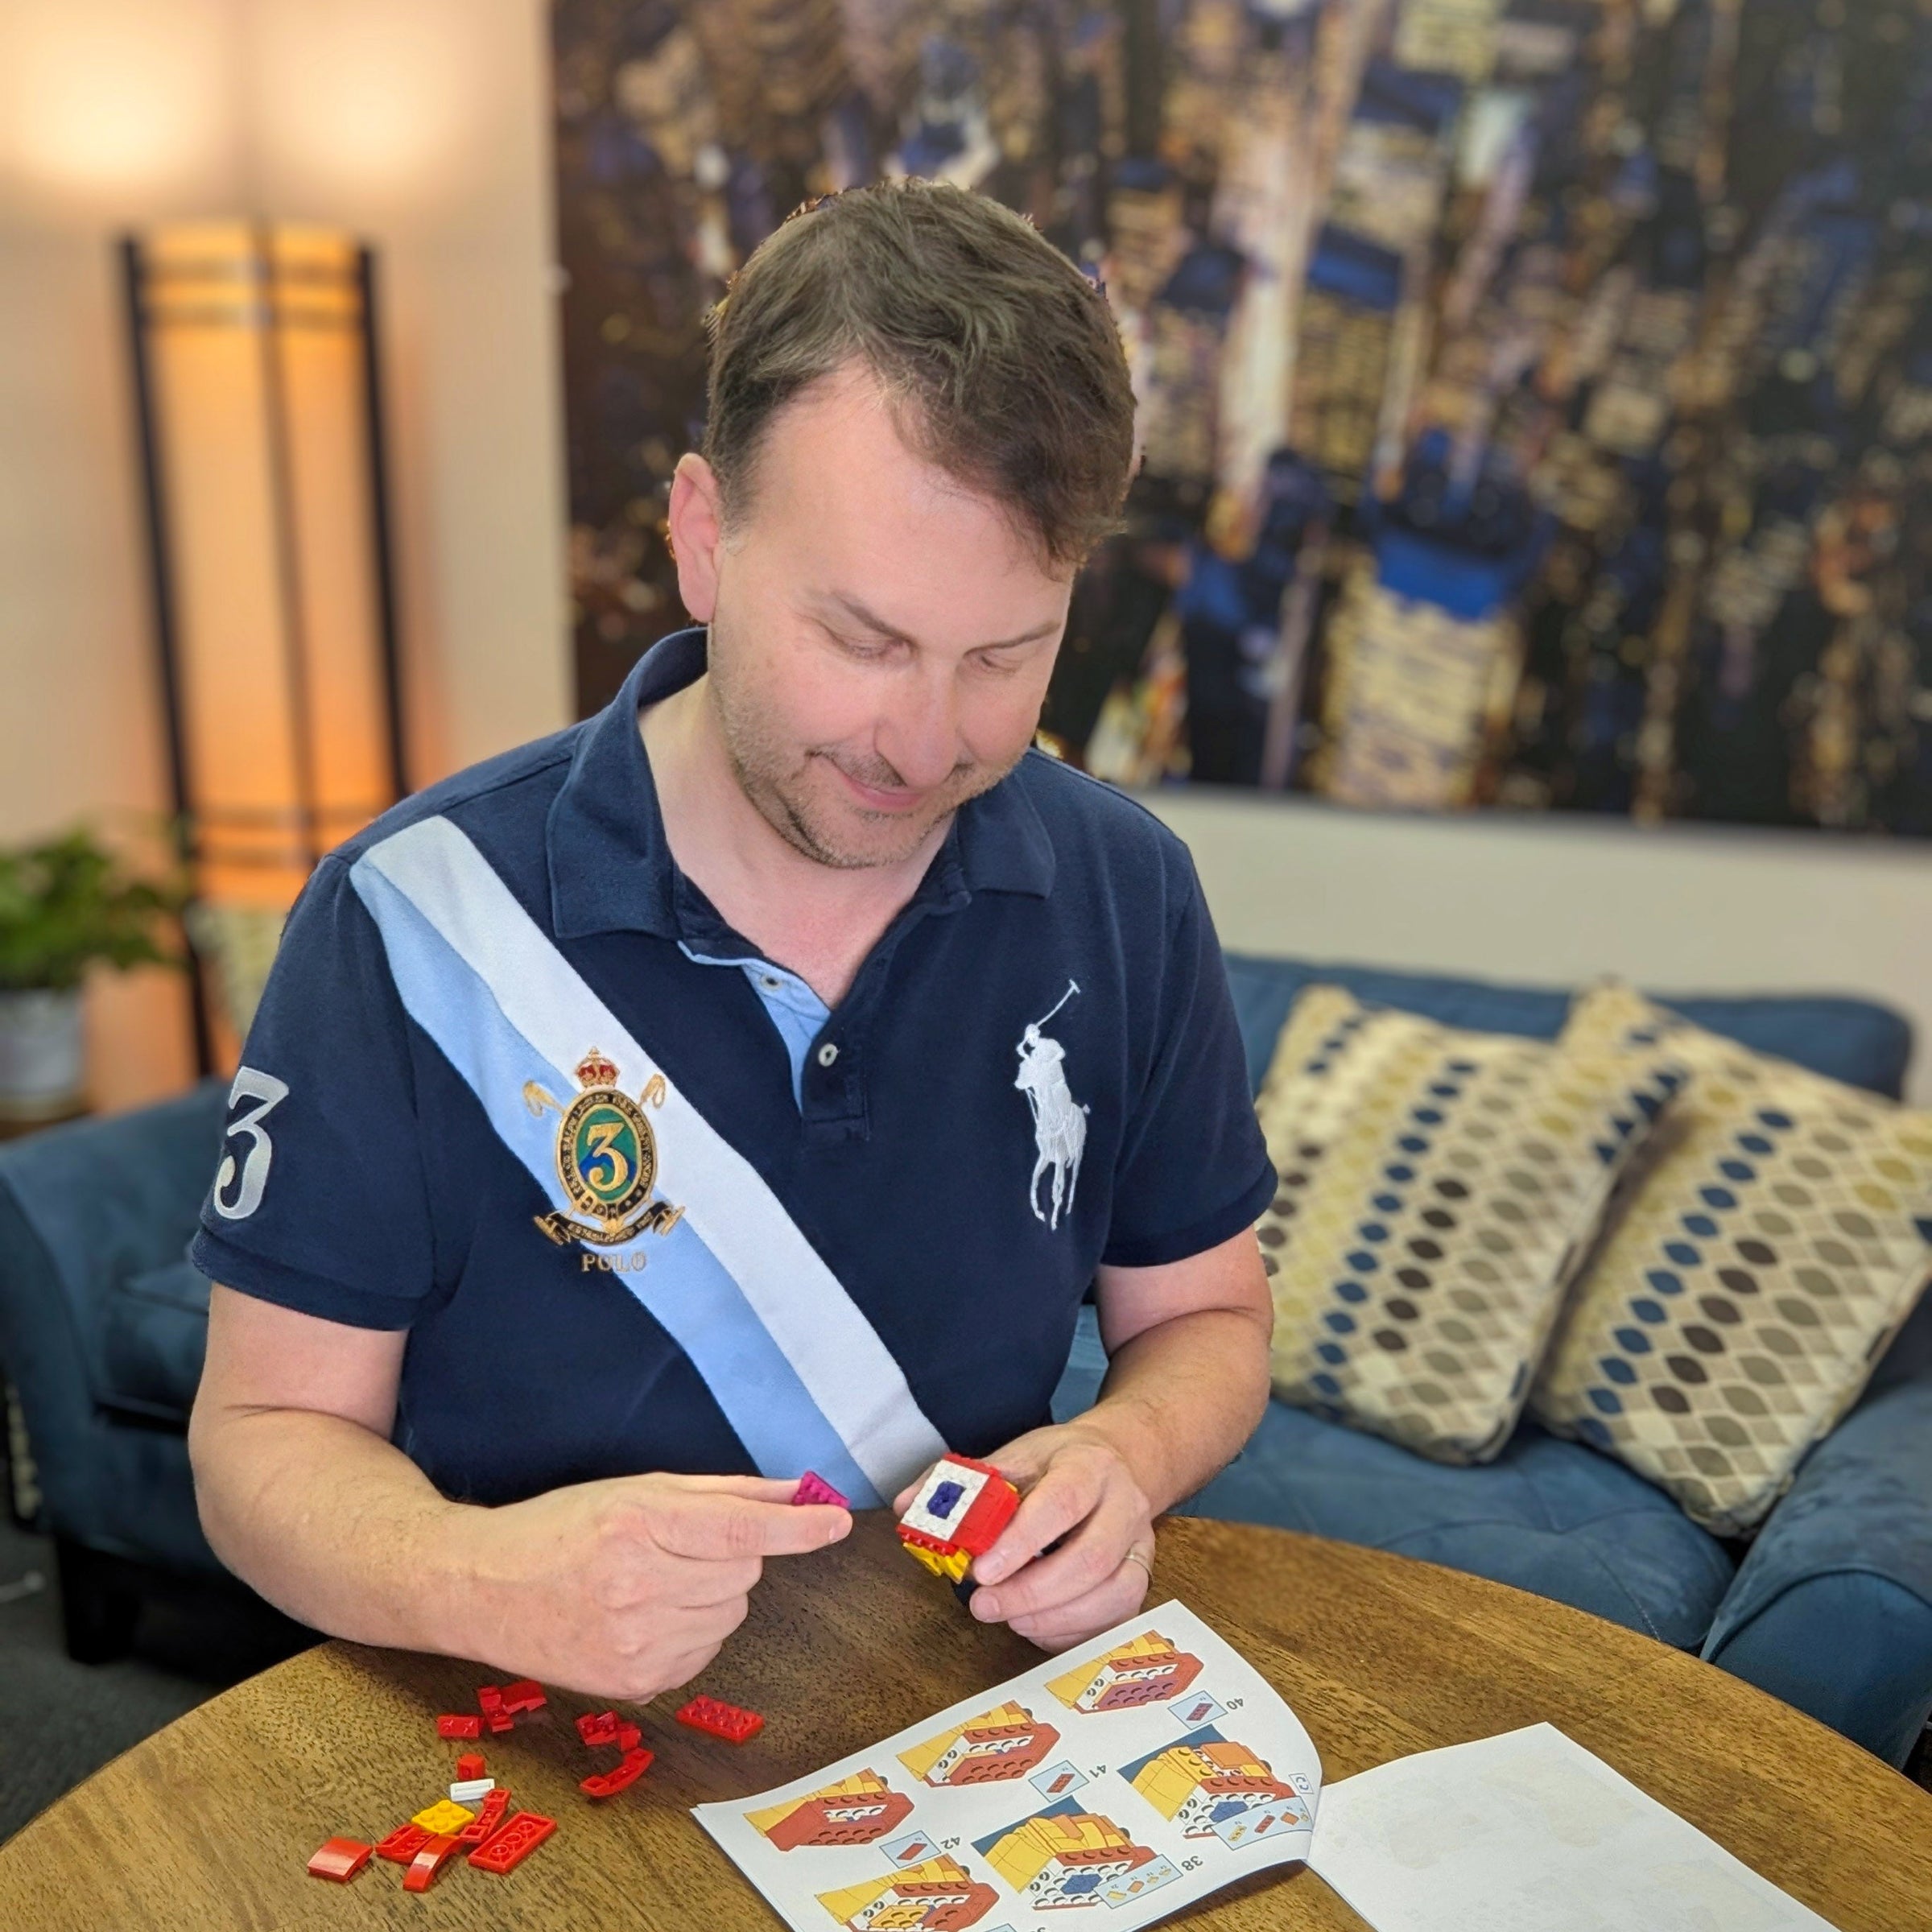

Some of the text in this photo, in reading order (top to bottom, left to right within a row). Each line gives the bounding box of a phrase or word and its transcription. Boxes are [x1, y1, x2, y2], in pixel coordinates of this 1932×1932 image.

[214, 1066, 289, 1220] 3
[587, 1122, 628, 1191] 3
[581, 1252, 647, 1273] POLO
[1226, 1697, 1244, 1710] 40
[1089, 1764, 1107, 1778] 41
[940, 1836, 961, 1850] 42
[1181, 1855, 1203, 1872] 38
